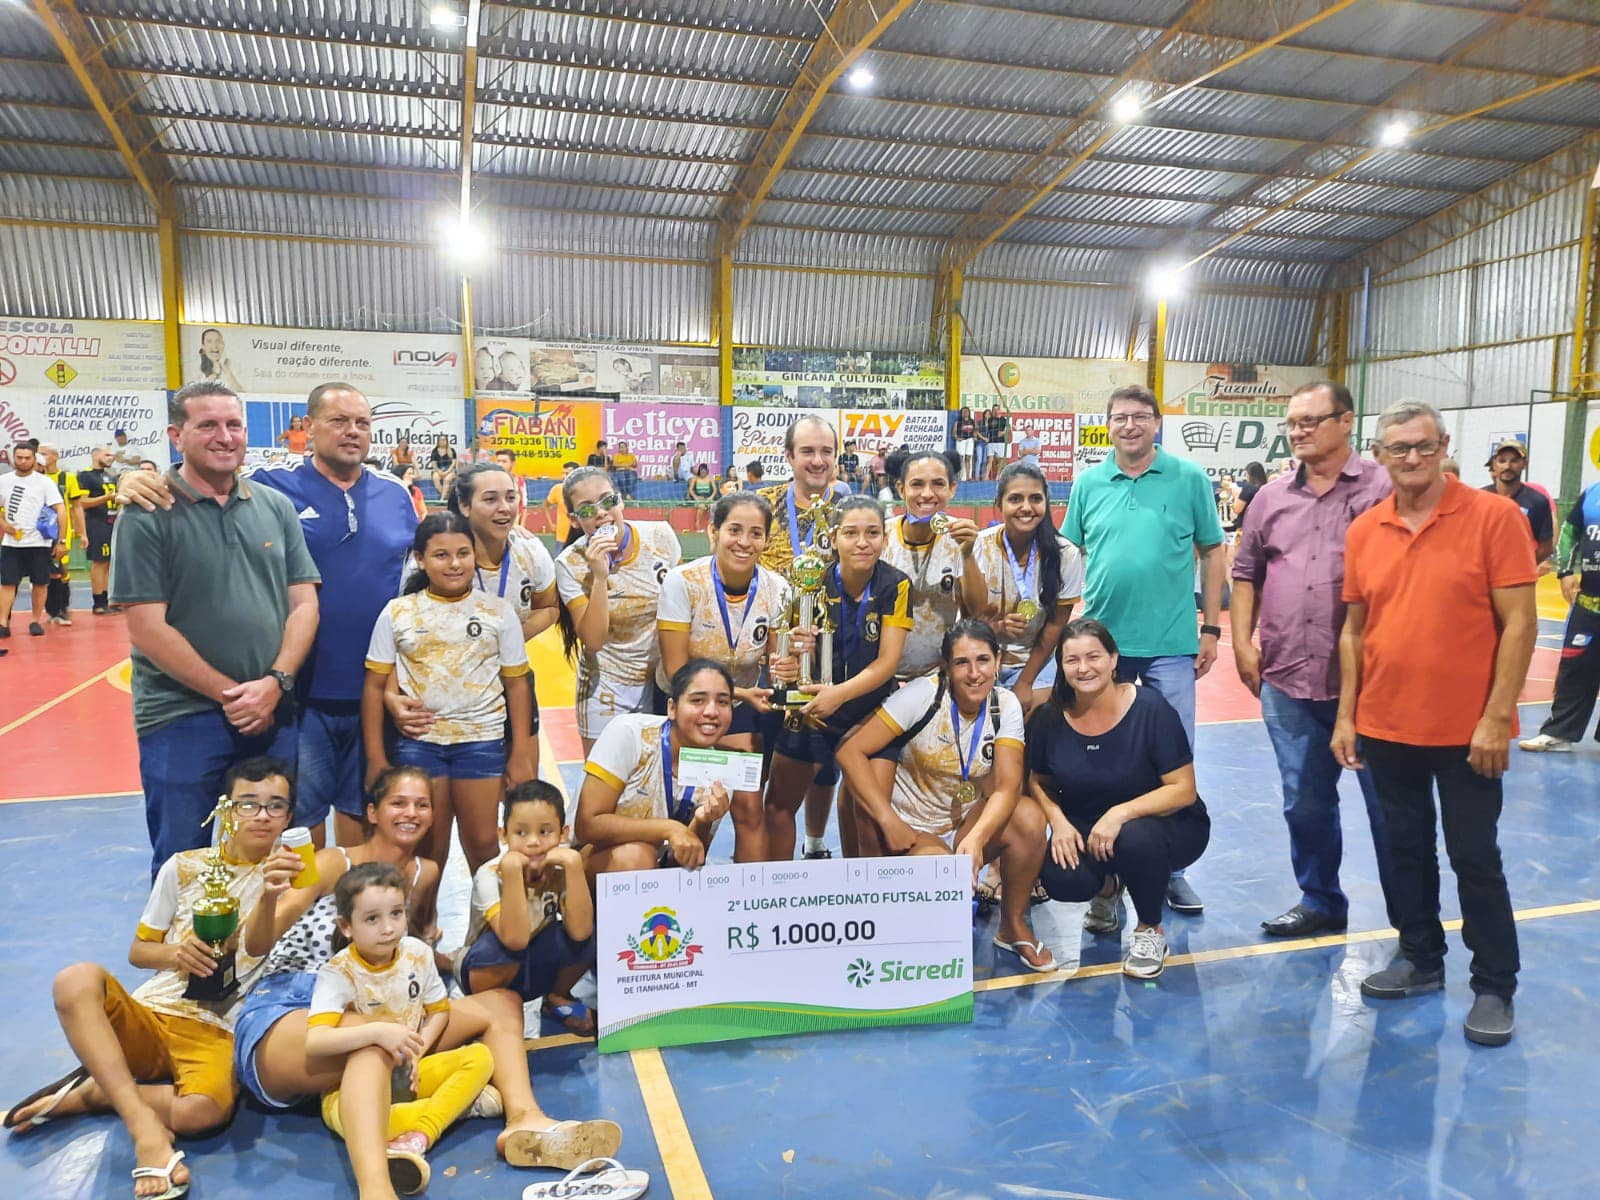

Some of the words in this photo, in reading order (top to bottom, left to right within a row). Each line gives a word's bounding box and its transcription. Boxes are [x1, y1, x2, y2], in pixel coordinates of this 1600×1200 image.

[252, 339, 287, 350] Visual
[290, 341, 344, 354] diferente,
[570, 343, 626, 353] COMUNICAÇÃO
[276, 355, 316, 367] reação
[319, 357, 372, 368] diferente.
[781, 373, 835, 382] GINCANA
[839, 374, 897, 384] CULTURAL
[1203, 375, 1277, 396] Fazenda
[48, 394, 140, 407] ALINHAMENTO
[962, 393, 1066, 410] ERTIAGRO
[48, 407, 153, 420] BALANCEAMENTO
[756, 412, 807, 427] RODN
[905, 416, 938, 424] BATATA
[48, 419, 84, 431] TROCA
[89, 420, 101, 431] DE
[107, 417, 138, 432] ÓLEO
[494, 415, 576, 436] FIABANI
[605, 408, 720, 439] Leticya
[845, 413, 905, 438] TAY
[904, 424, 944, 433] RECHEADA
[1015, 418, 1073, 431] COMPRE
[371, 428, 393, 445] uto
[544, 436, 577, 450] TINTAS
[903, 434, 943, 443] CACHORRO
[1039, 431, 1072, 446] BEM
[606, 436, 688, 453] Ppelari
[737, 446, 778, 455] PLACAS
[908, 443, 935, 451] UENTE
[696, 450, 718, 465] MIL
[758, 455, 787, 464] LETRE
[8, 485, 26, 522] PUMA
[772, 871, 809, 881] 00000-0
[877, 867, 914, 876] 00000-0
[743, 897, 787, 911] LUGAR
[790, 892, 880, 909] CAMPEONATO
[882, 890, 932, 903] FUTSAL
[934, 890, 964, 901] 2021
[728, 922, 760, 950] R$
[772, 920, 875, 945] 1.000,00
[617, 973, 662, 984] PREFEITURA
[663, 969, 704, 980] MUNICIPAL
[880, 958, 964, 983] Sicredi
[624, 986, 634, 995] DE
[686, 981, 698, 989] MT
